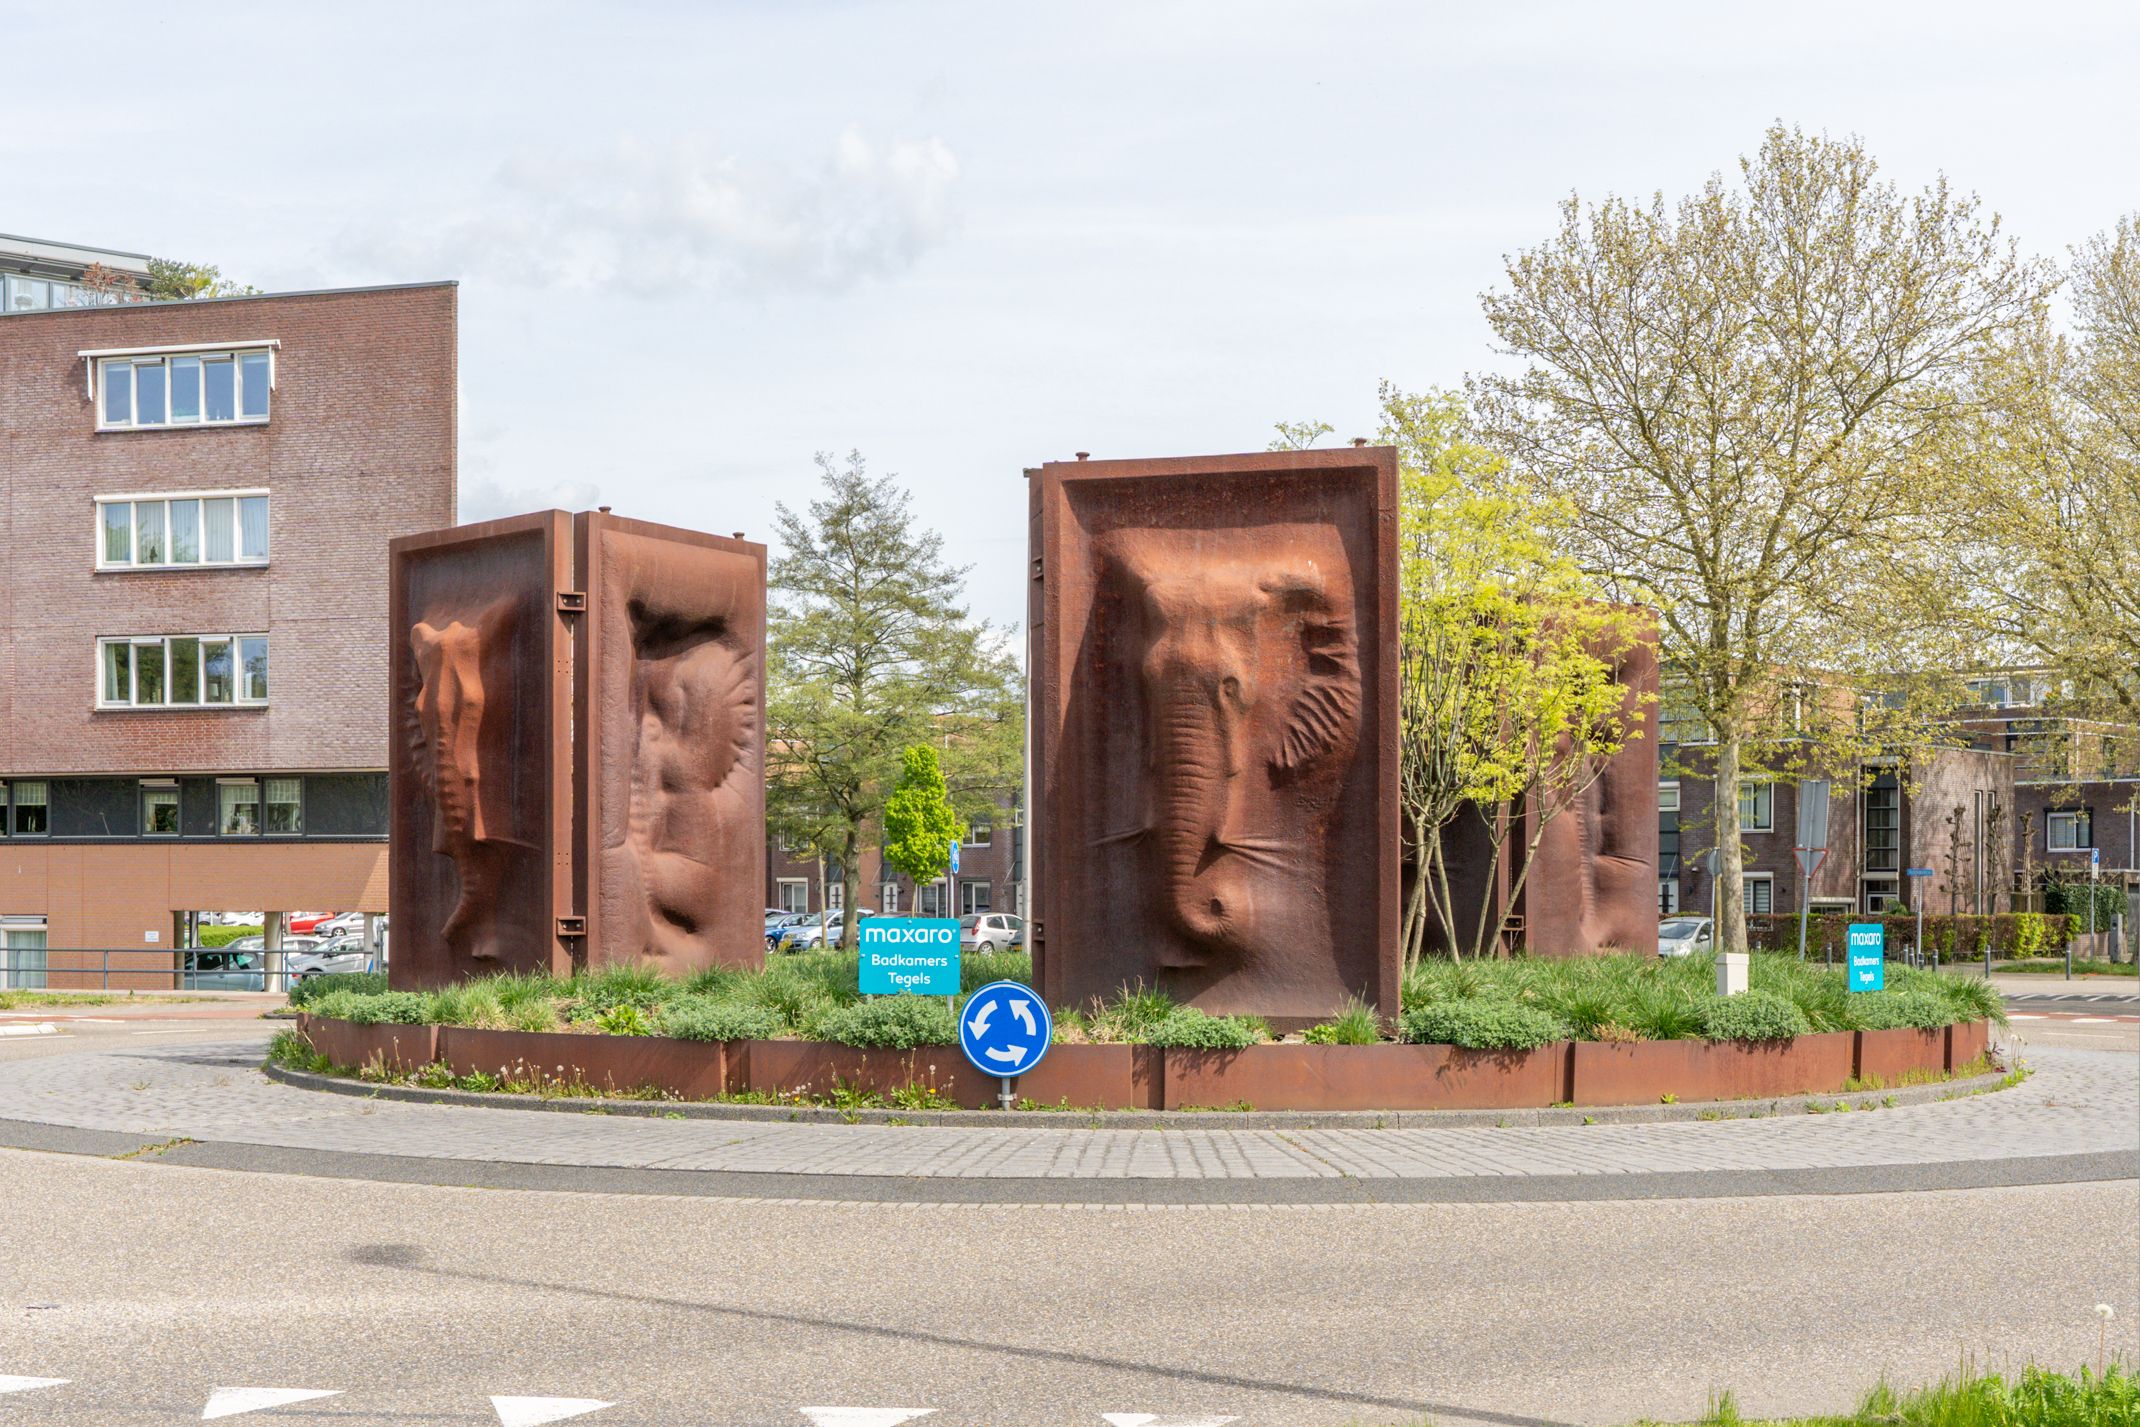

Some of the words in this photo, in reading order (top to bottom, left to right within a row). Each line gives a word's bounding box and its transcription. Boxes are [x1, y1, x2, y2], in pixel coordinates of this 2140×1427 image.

[865, 927, 953, 944] maxaro
[1851, 932, 1881, 946] maxaro
[871, 953, 949, 967] Badkamers
[1853, 955, 1880, 966] Badkamers
[887, 971, 931, 988] Tegels
